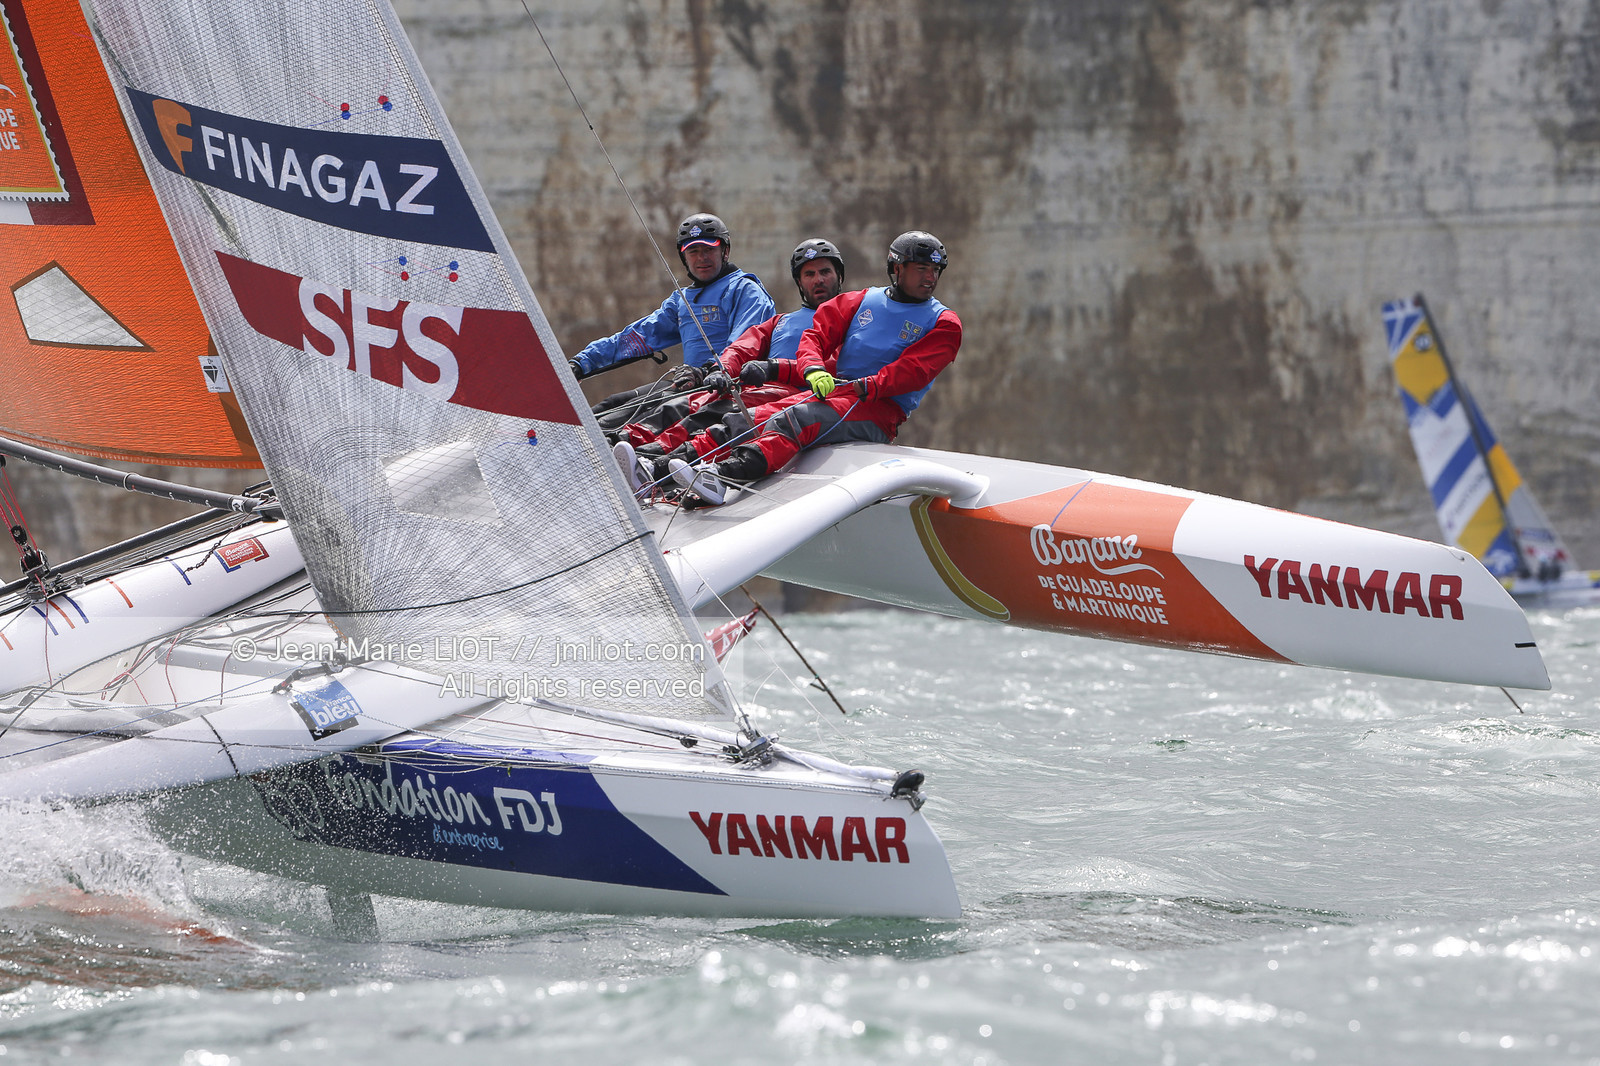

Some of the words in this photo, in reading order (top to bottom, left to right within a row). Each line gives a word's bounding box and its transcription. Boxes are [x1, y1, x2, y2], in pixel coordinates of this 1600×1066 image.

[201, 125, 439, 216] FINAGAZ
[299, 277, 465, 403] SFS
[1030, 523, 1164, 576] Banane
[1038, 575, 1057, 590] DE
[1055, 573, 1167, 605] GUADELOUPE
[1051, 593, 1065, 610] &
[1063, 594, 1169, 625] MARTINIQUE
[1243, 554, 1465, 621] YANMAR
[310, 700, 361, 727] bleu
[319, 752, 492, 826] Fondation
[493, 786, 564, 836] FDJ
[432, 823, 504, 852] d'entreprise
[688, 811, 911, 864] YANMAR
